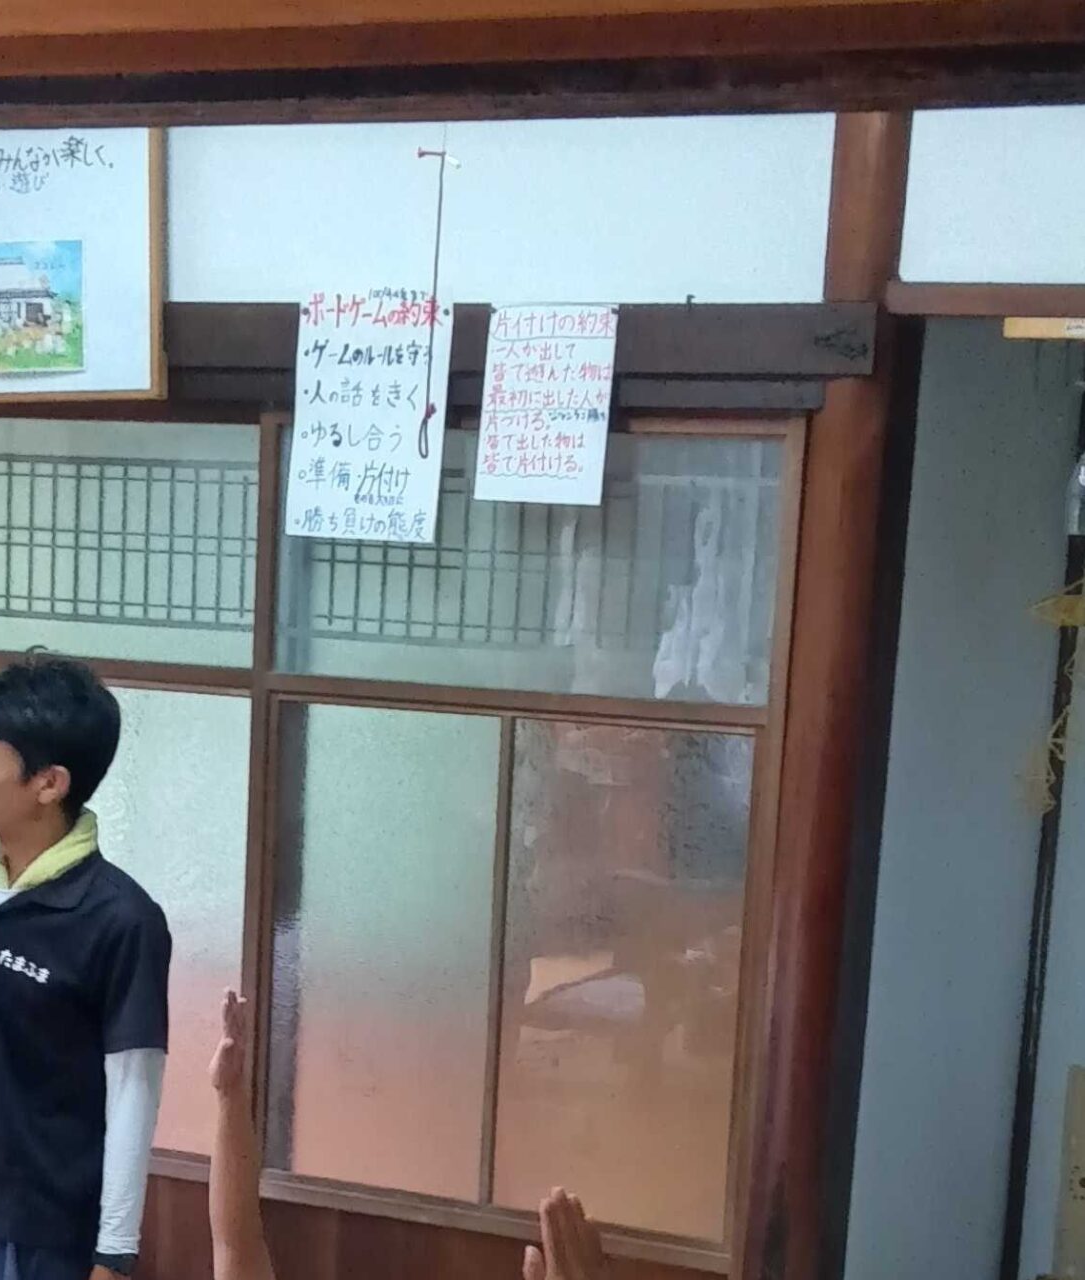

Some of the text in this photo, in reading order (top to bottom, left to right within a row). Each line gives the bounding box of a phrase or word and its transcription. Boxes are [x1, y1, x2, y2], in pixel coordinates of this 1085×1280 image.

[494, 309, 614, 338] 片付けの約束
